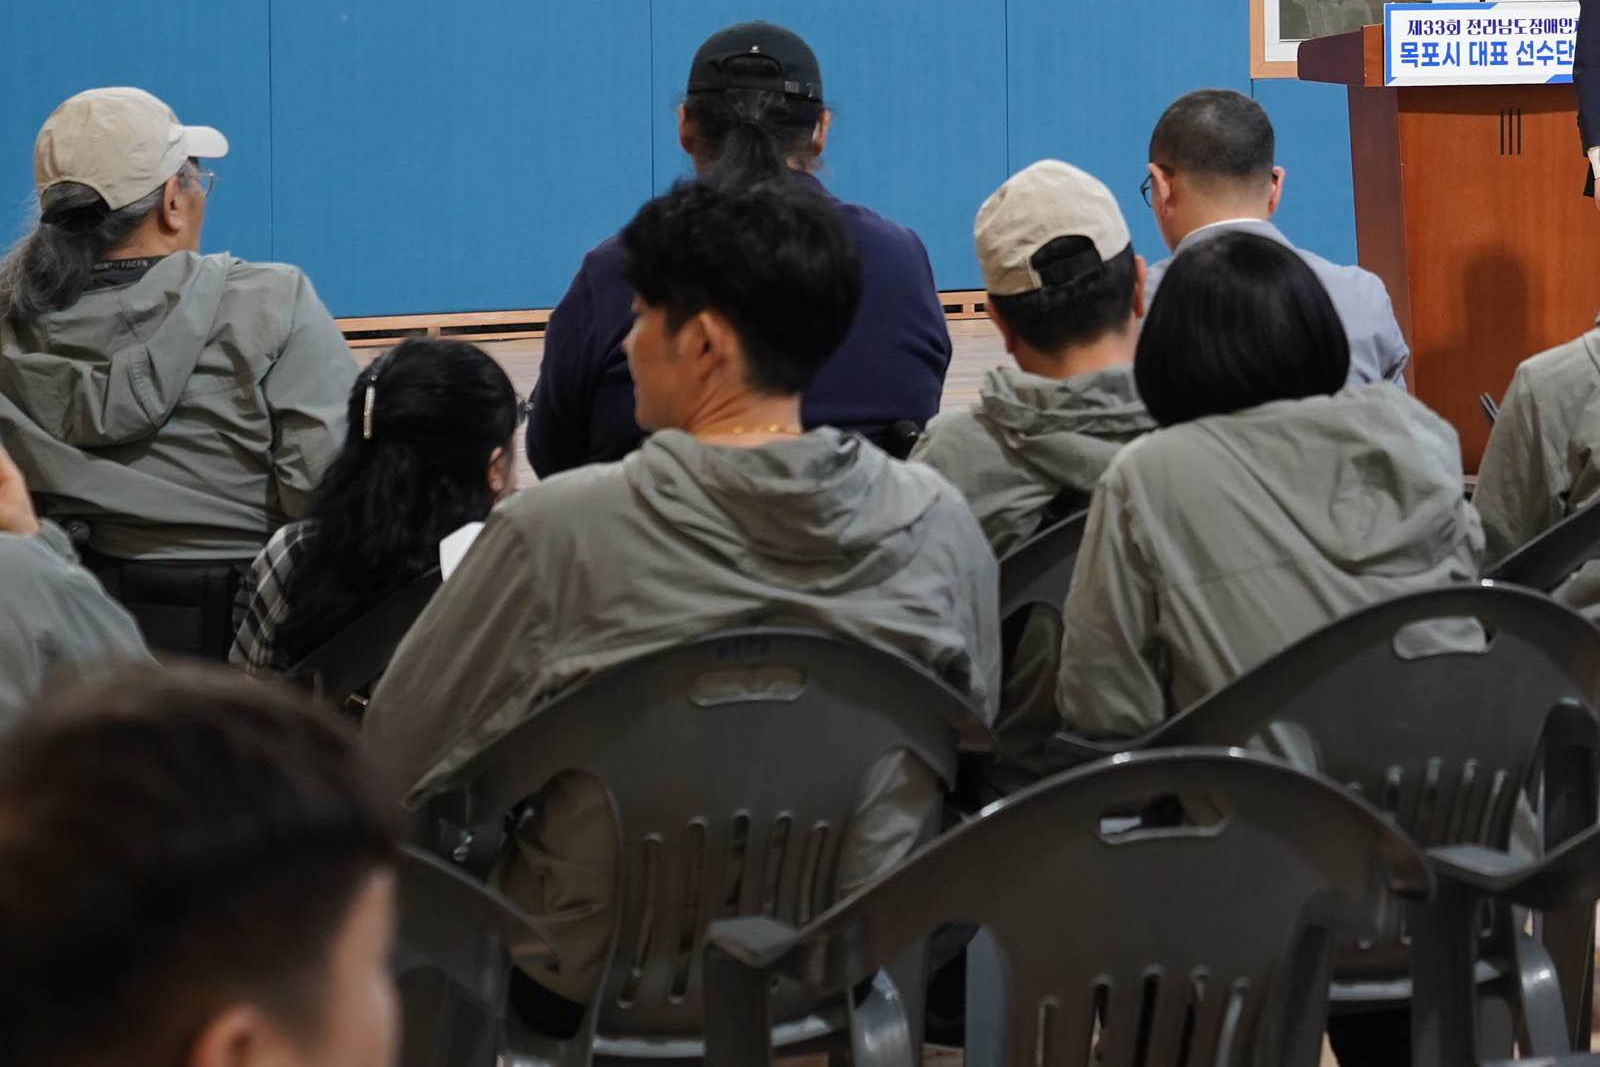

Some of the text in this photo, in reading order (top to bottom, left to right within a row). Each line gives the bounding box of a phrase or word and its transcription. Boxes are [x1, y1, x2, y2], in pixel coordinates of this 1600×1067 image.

[1407, 19, 1461, 36] 제33회
[1400, 39, 1575, 68] 목포시 대표 선수단
